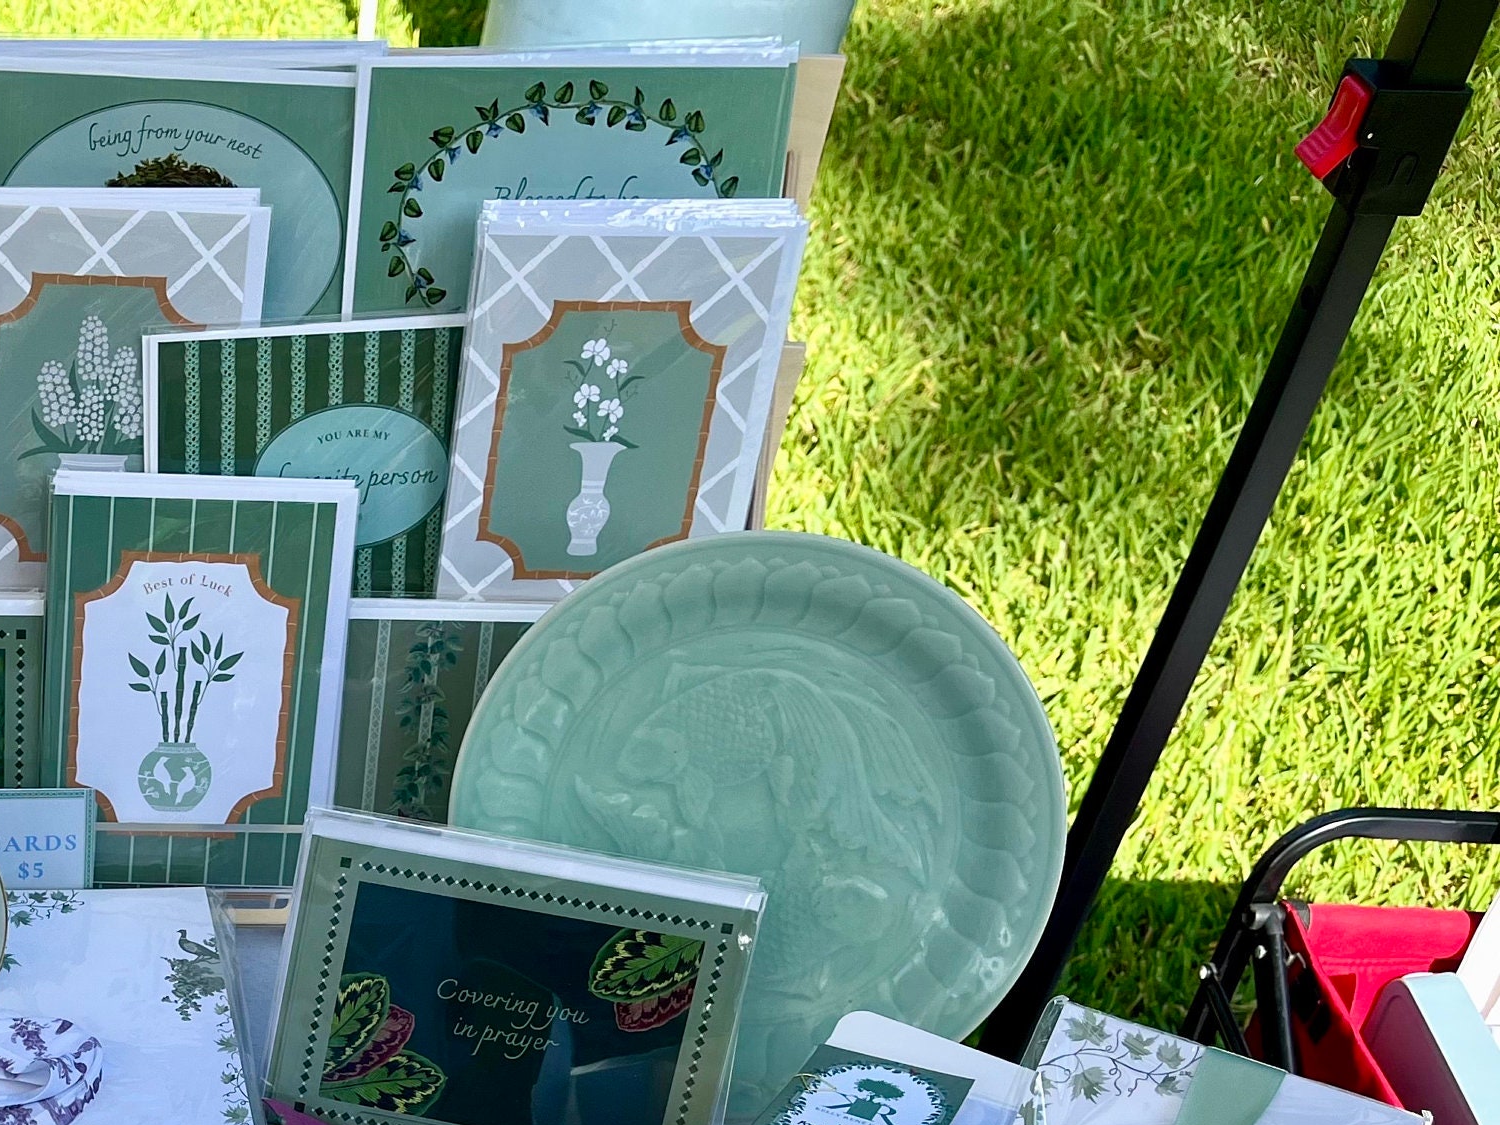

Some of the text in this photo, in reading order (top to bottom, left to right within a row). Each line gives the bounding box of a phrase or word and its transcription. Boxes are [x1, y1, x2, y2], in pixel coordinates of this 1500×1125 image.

[88, 115, 263, 159] being from your nest
[316, 429, 391, 445] YOU ARE MY
[360, 468, 439, 505] person
[142, 573, 233, 598] Best of Luck
[18, 861, 44, 880] $5
[436, 978, 590, 1031] Covering you
[453, 1017, 561, 1060] in prayer
